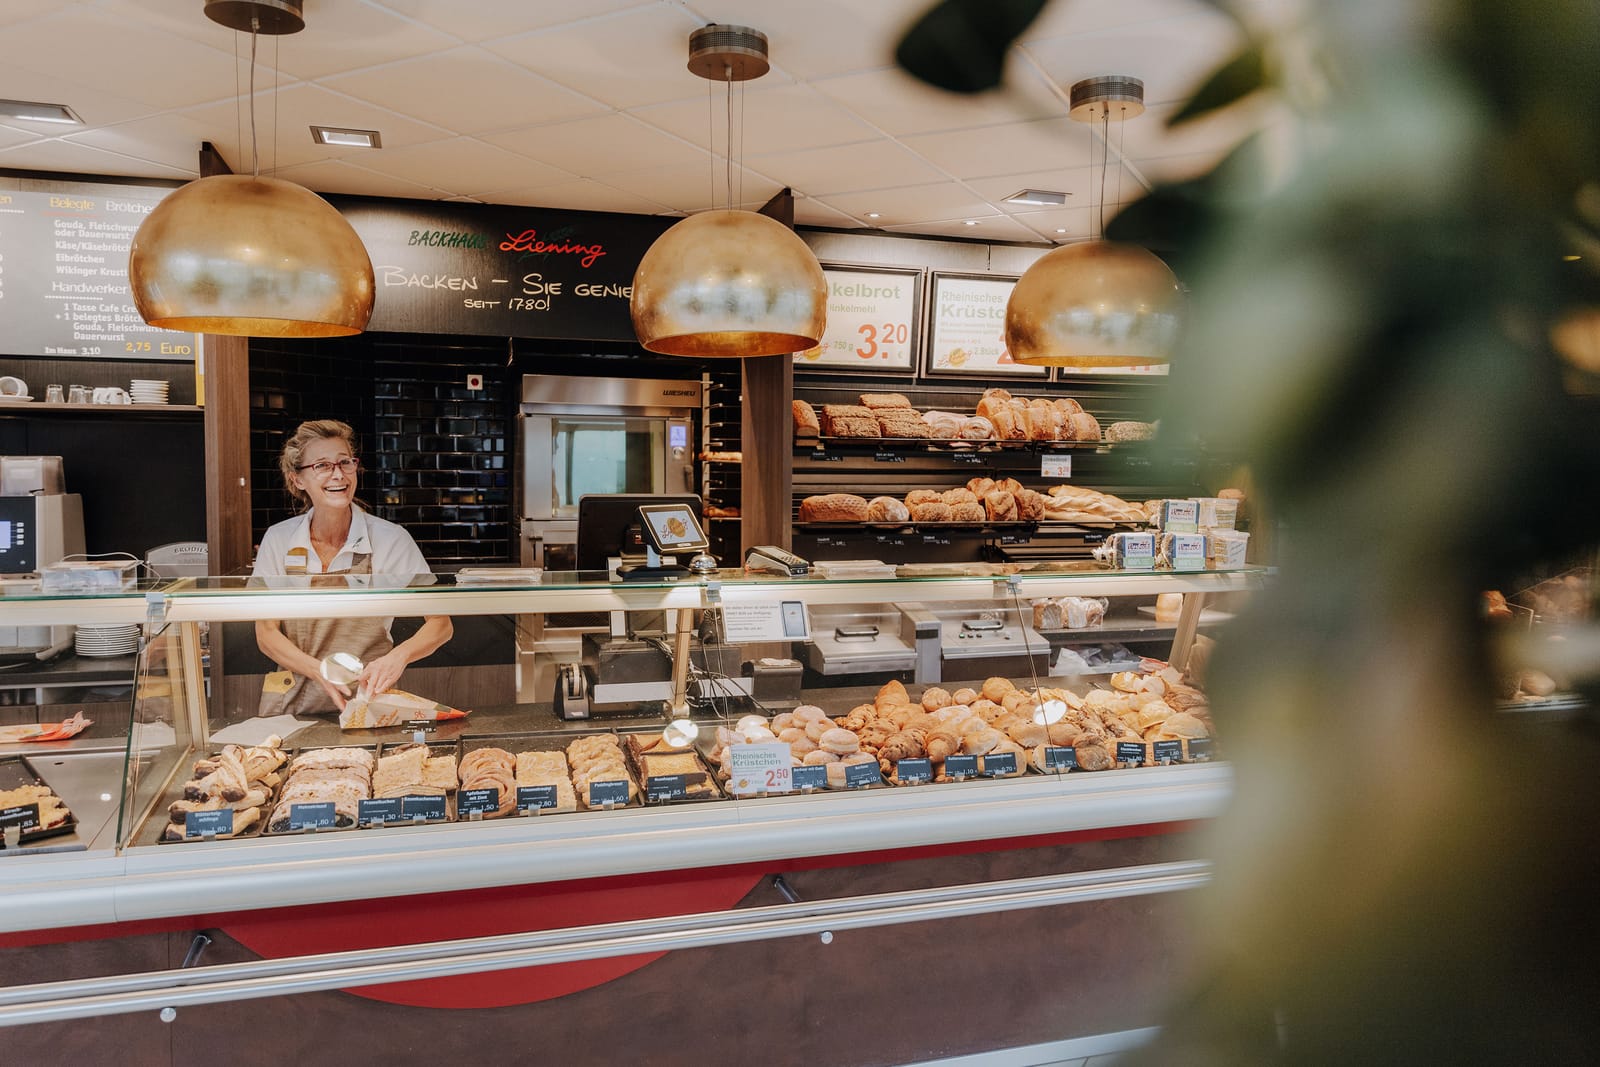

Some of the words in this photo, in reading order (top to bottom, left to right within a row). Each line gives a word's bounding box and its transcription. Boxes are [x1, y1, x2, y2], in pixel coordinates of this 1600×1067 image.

[50, 197, 96, 211] Belegte
[54, 220, 86, 230] Gouda,
[55, 229, 76, 237] oder
[79, 230, 130, 240] Dauerwurst
[499, 229, 607, 268] Liening
[56, 266, 98, 277] Wikinger
[376, 265, 478, 291] BACKEN
[52, 281, 127, 295] Handwerker
[72, 303, 96, 312] Tasse
[464, 298, 502, 309] SEIT
[508, 295, 550, 311] 1780!
[72, 313, 112, 323] belegtes
[73, 322, 105, 332] Gouda,
[73, 332, 125, 341] Dauerwurst
[126, 342, 152, 353] 2,75
[161, 343, 191, 355] Euro
